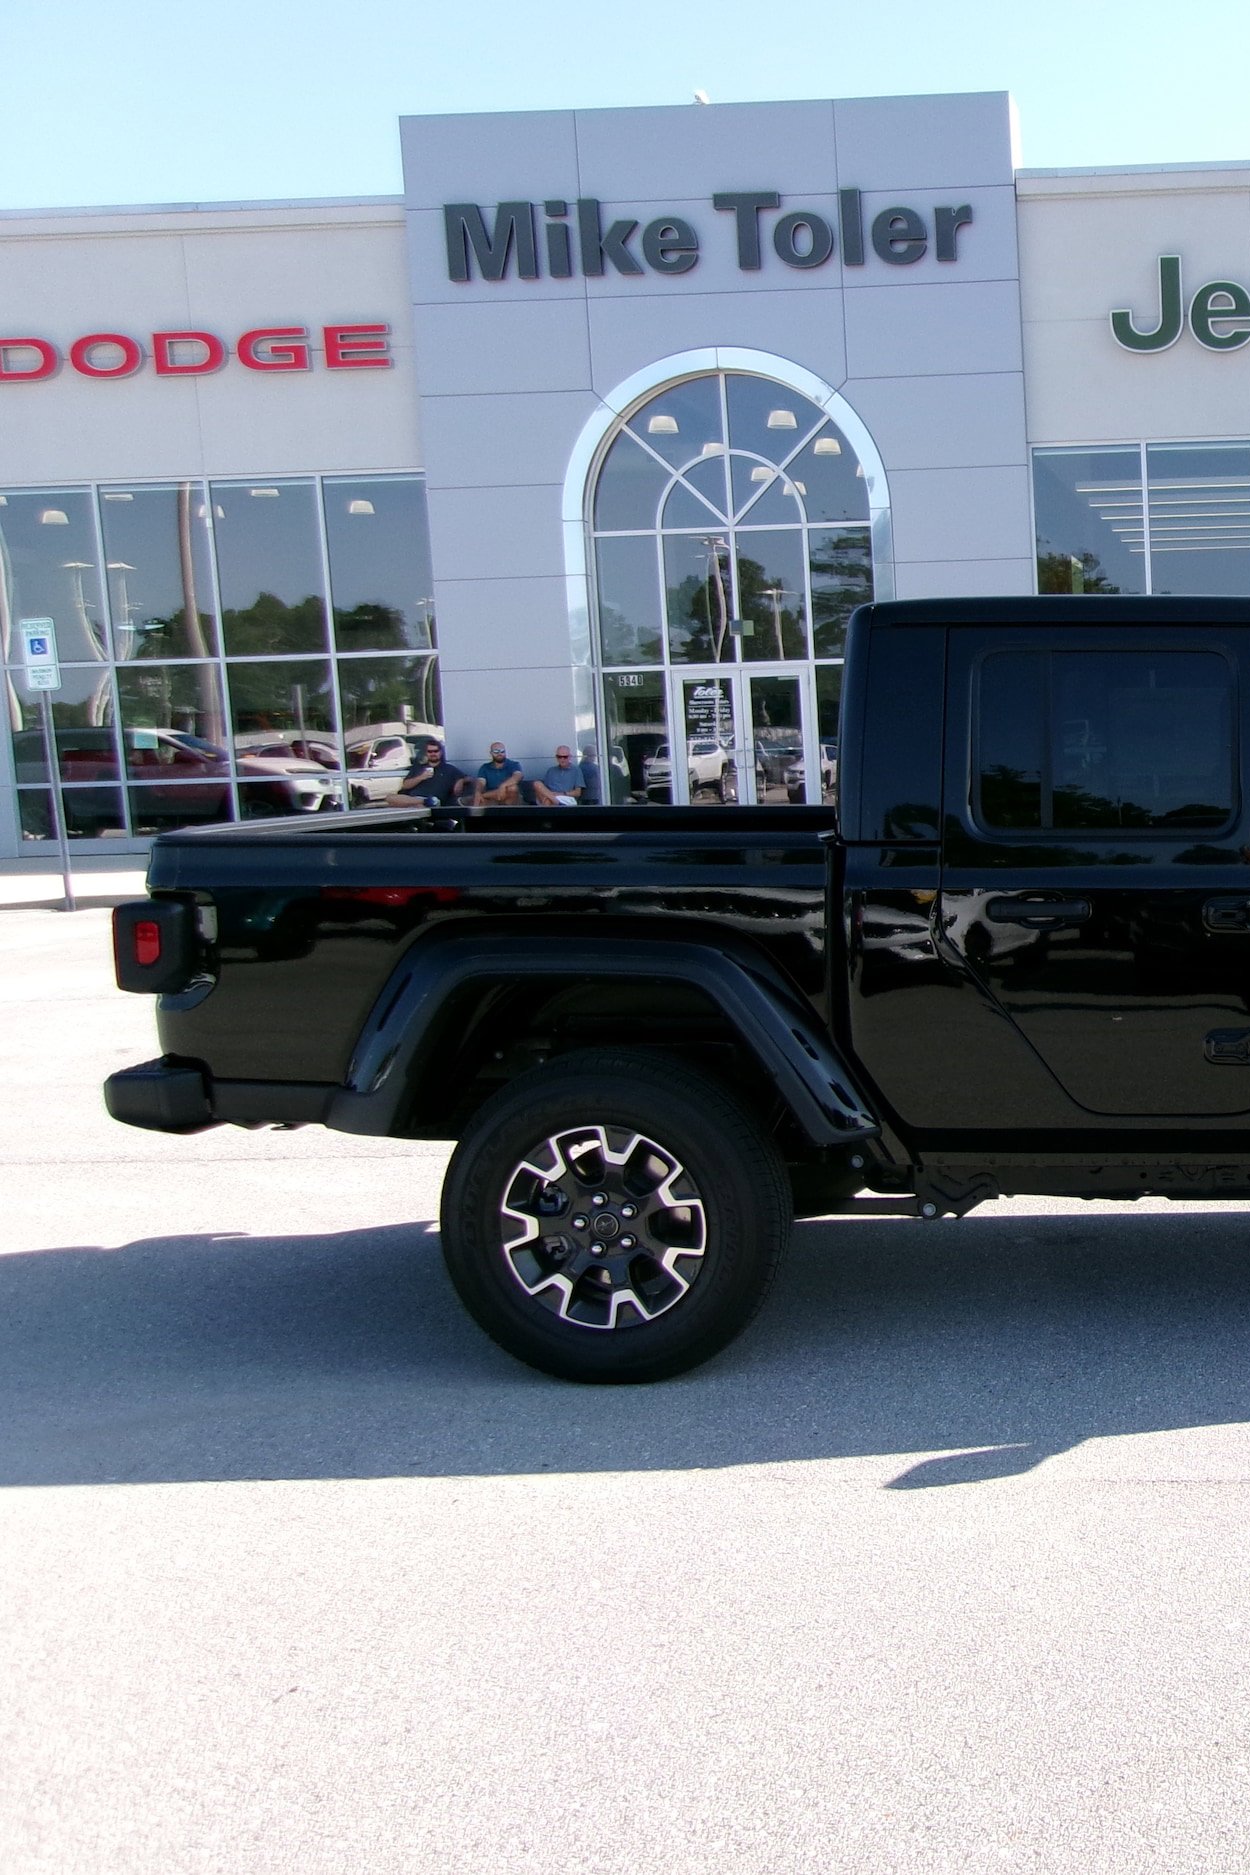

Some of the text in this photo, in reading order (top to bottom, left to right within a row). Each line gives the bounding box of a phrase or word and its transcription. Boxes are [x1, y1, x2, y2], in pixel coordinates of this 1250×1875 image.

[443, 188, 973, 283] Mike Toler
[0, 323, 392, 382] DODGE
